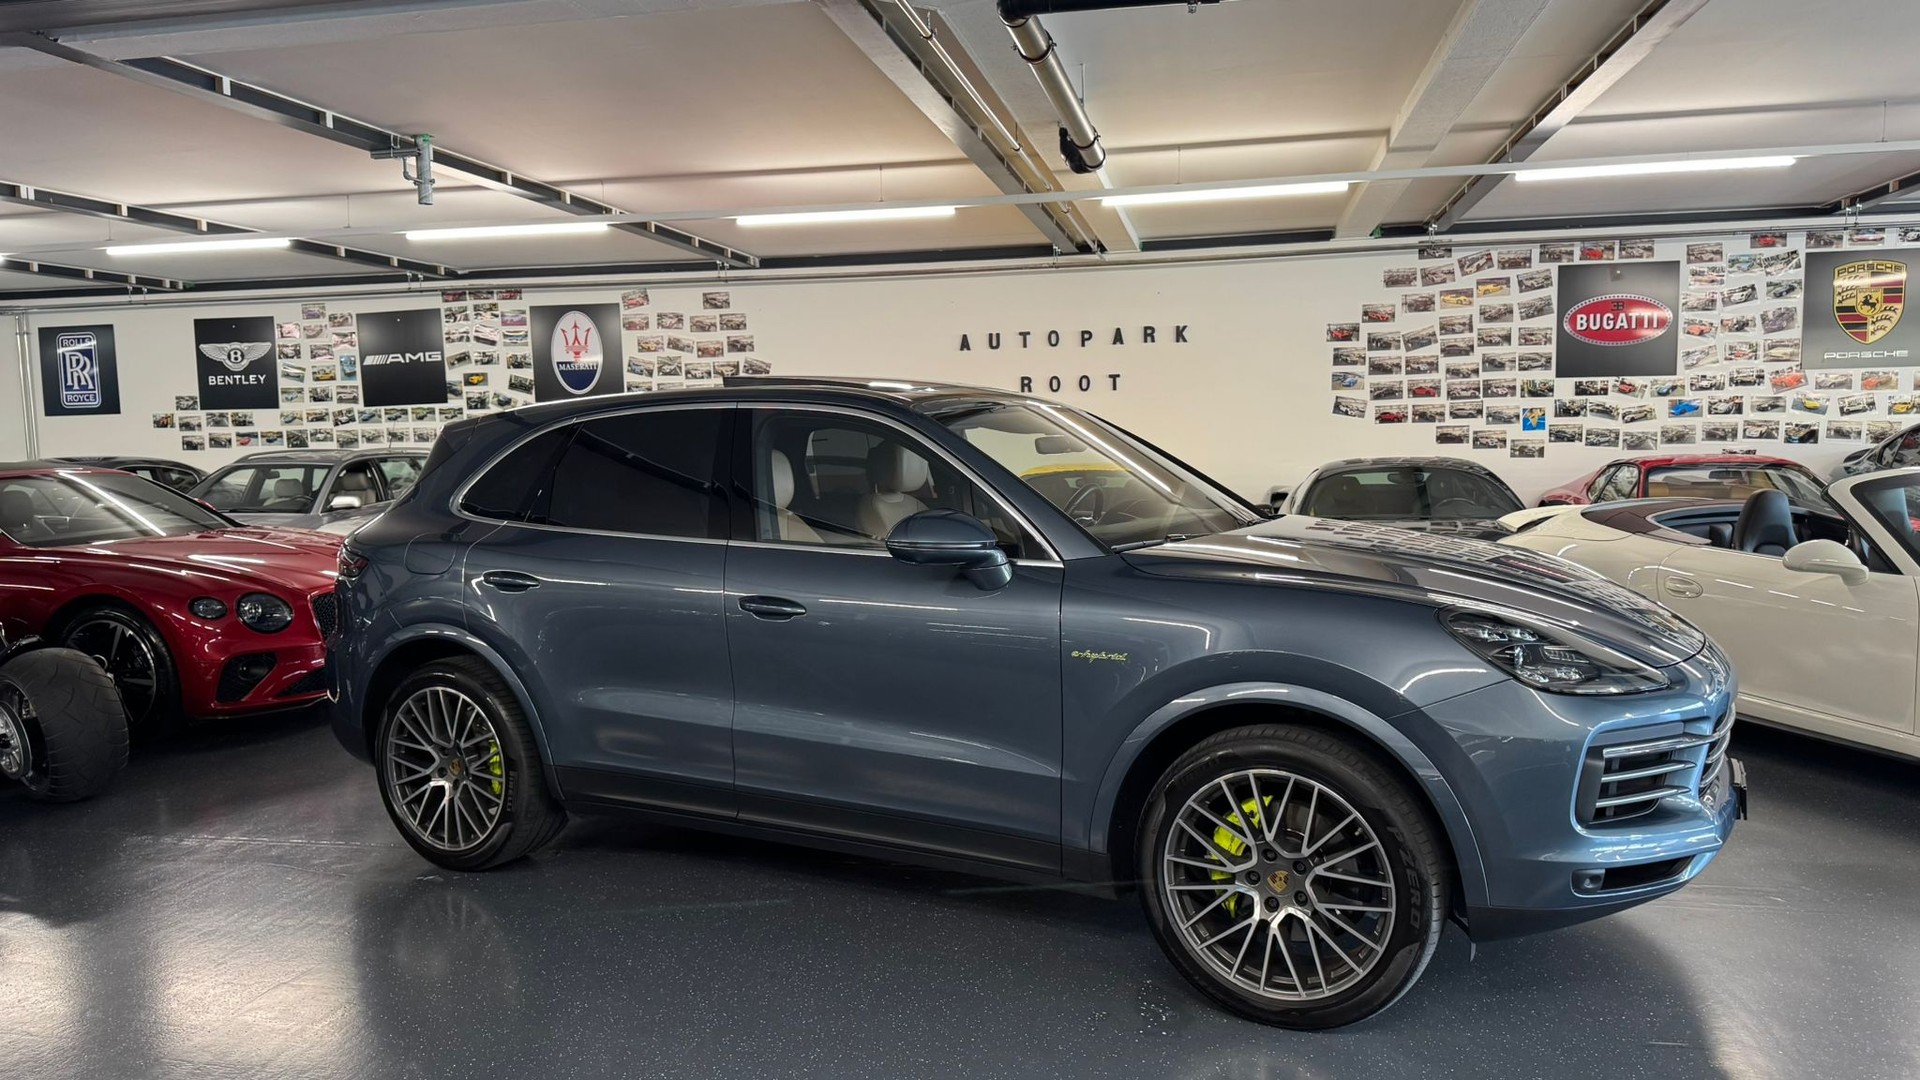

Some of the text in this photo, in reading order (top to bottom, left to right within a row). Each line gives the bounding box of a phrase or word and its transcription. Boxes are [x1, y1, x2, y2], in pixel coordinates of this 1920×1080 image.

[1837, 263, 1903, 277] PORSCHE
[1576, 312, 1660, 331] BUGATTI
[62, 338, 92, 347] ROLLS
[959, 325, 1188, 351] AUTOPARK
[230, 349, 242, 362] B
[1822, 350, 1909, 361] PORSCHE
[558, 363, 597, 371] MASERATI
[208, 374, 266, 386] BENTLEY
[1020, 374, 1121, 393] ROOT
[67, 394, 96, 402] ROYCE
[1071, 650, 1128, 663] e-hybrid
